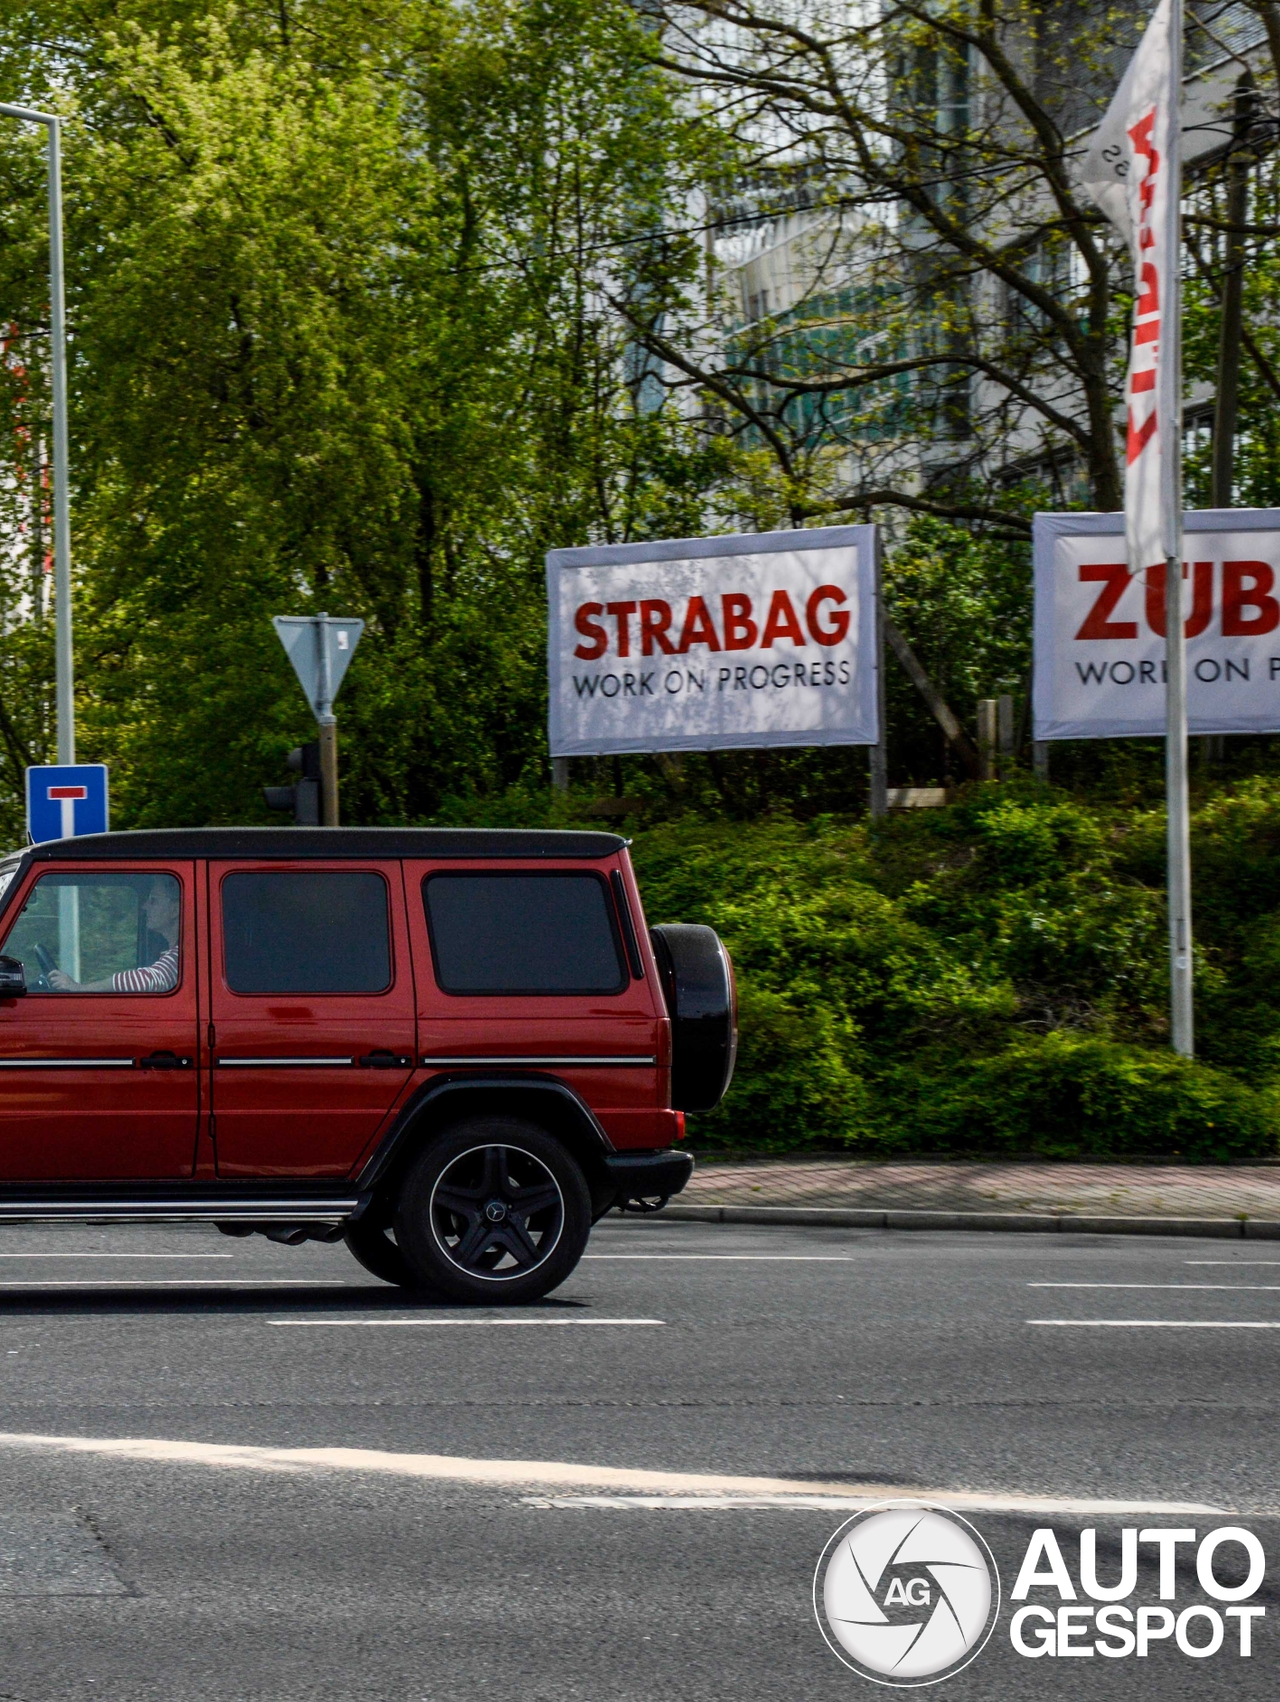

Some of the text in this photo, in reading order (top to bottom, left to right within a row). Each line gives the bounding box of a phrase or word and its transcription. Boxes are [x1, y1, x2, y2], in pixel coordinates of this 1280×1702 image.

[573, 584, 851, 660] STRABAG
[572, 660, 851, 698] WORK ON PROGRESS
[1075, 660, 1169, 685] WOR
[1194, 658, 1251, 683] ON
